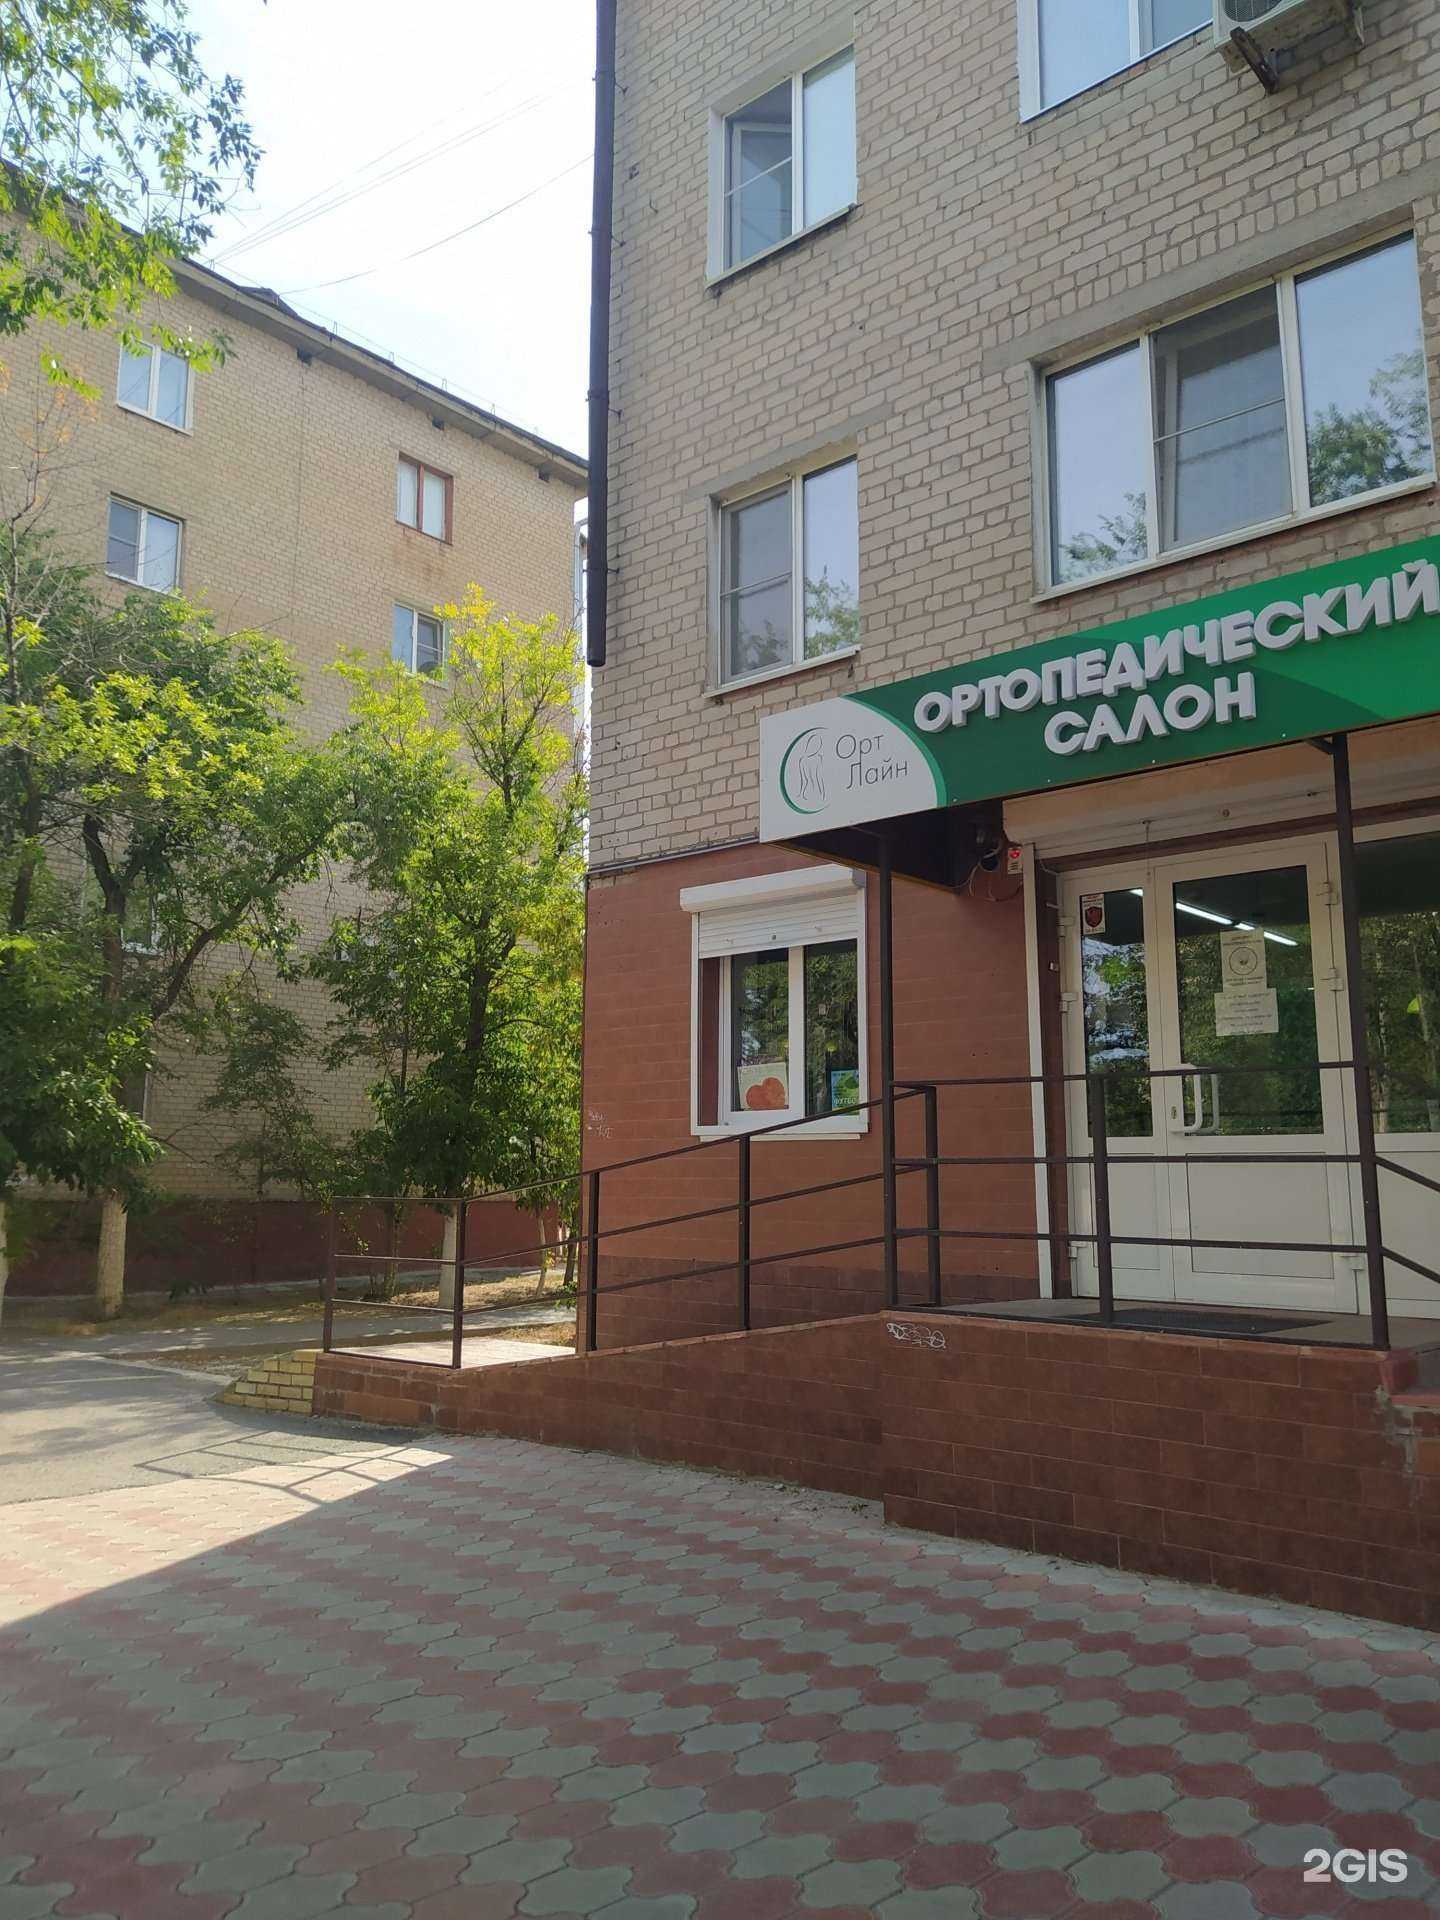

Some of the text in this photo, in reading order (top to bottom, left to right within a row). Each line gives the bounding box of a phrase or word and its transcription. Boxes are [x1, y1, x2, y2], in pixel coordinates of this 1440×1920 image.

[913, 558, 1440, 734] ОРТОПЕДИЧЕСКИЙ
[1043, 671, 1257, 756] САЛОН
[835, 733, 885, 767] Орт
[845, 757, 909, 790] Лайн
